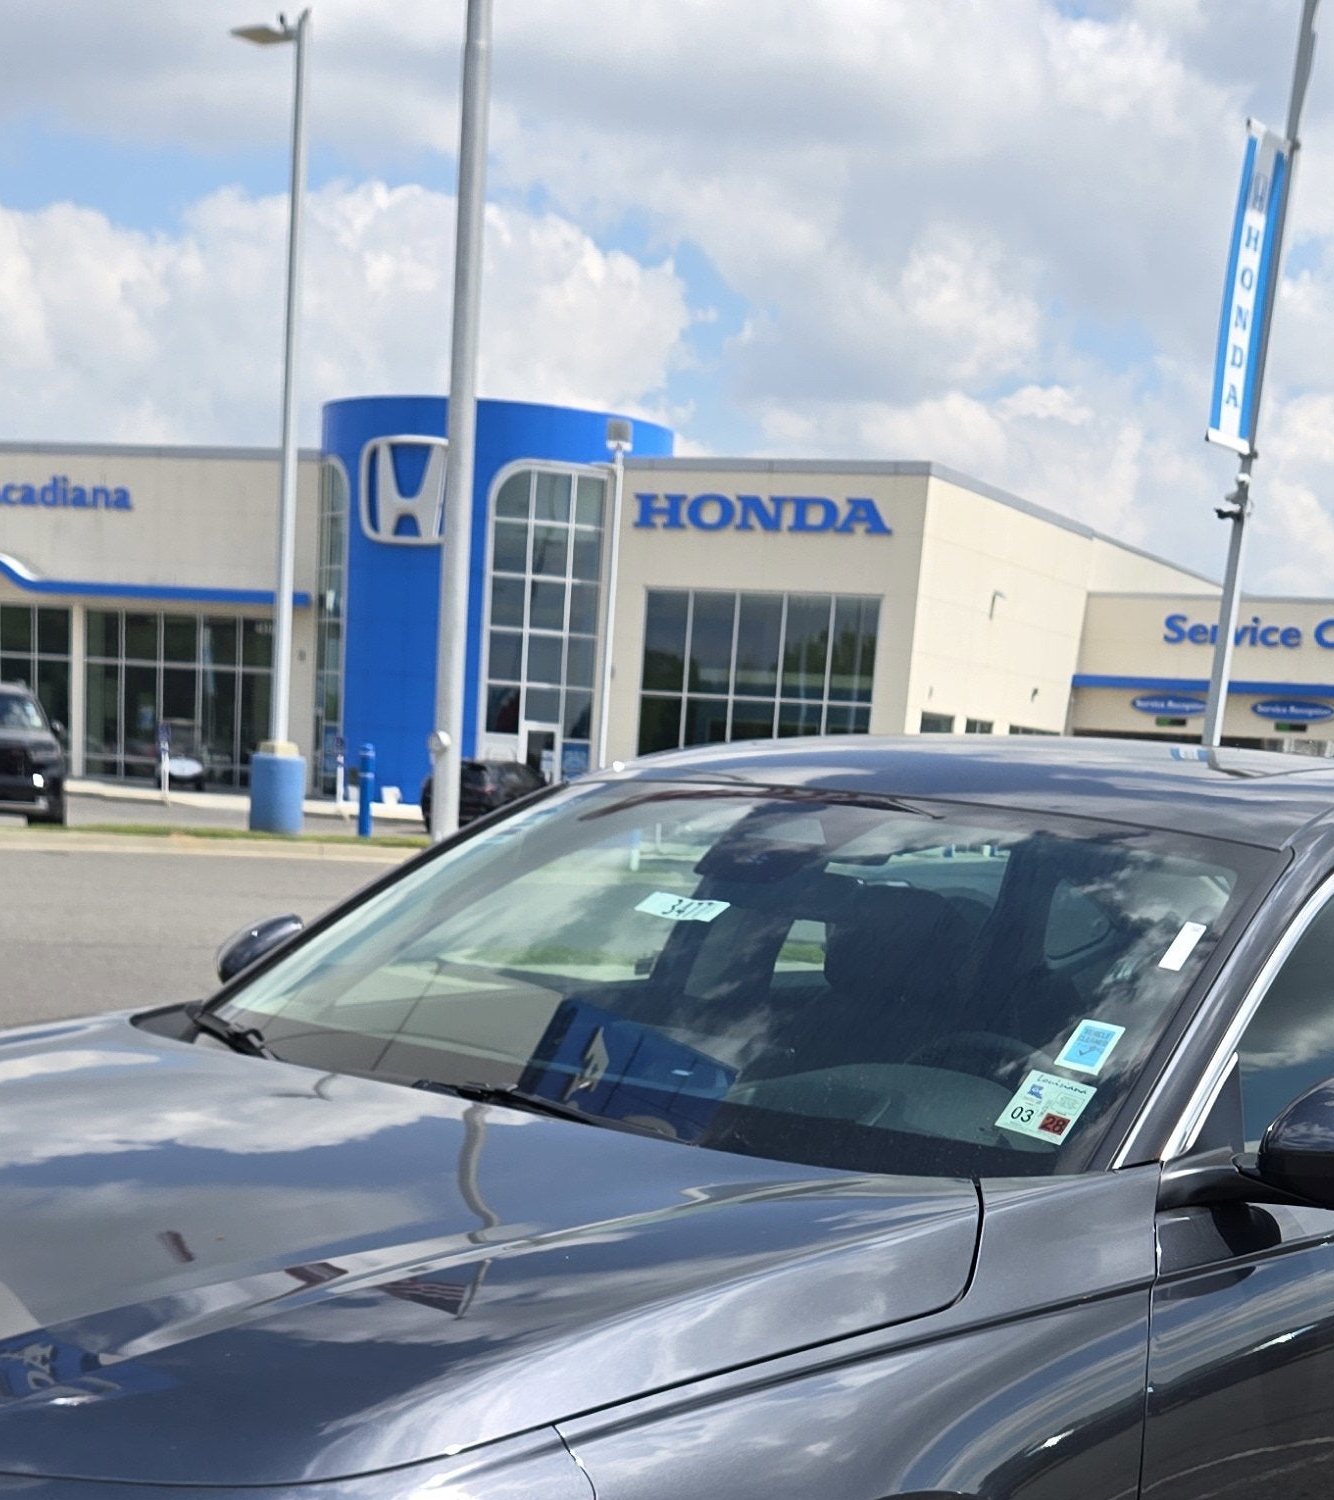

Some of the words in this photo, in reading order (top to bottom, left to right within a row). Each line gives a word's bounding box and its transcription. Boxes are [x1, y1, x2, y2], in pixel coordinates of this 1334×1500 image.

[1224, 224, 1260, 410] HONDA
[633, 492, 893, 536] HONDA
[1037, 1074, 1087, 1095] Louisiana
[1010, 1106, 1035, 1123] 03
[1039, 1115, 1064, 1133] 28
